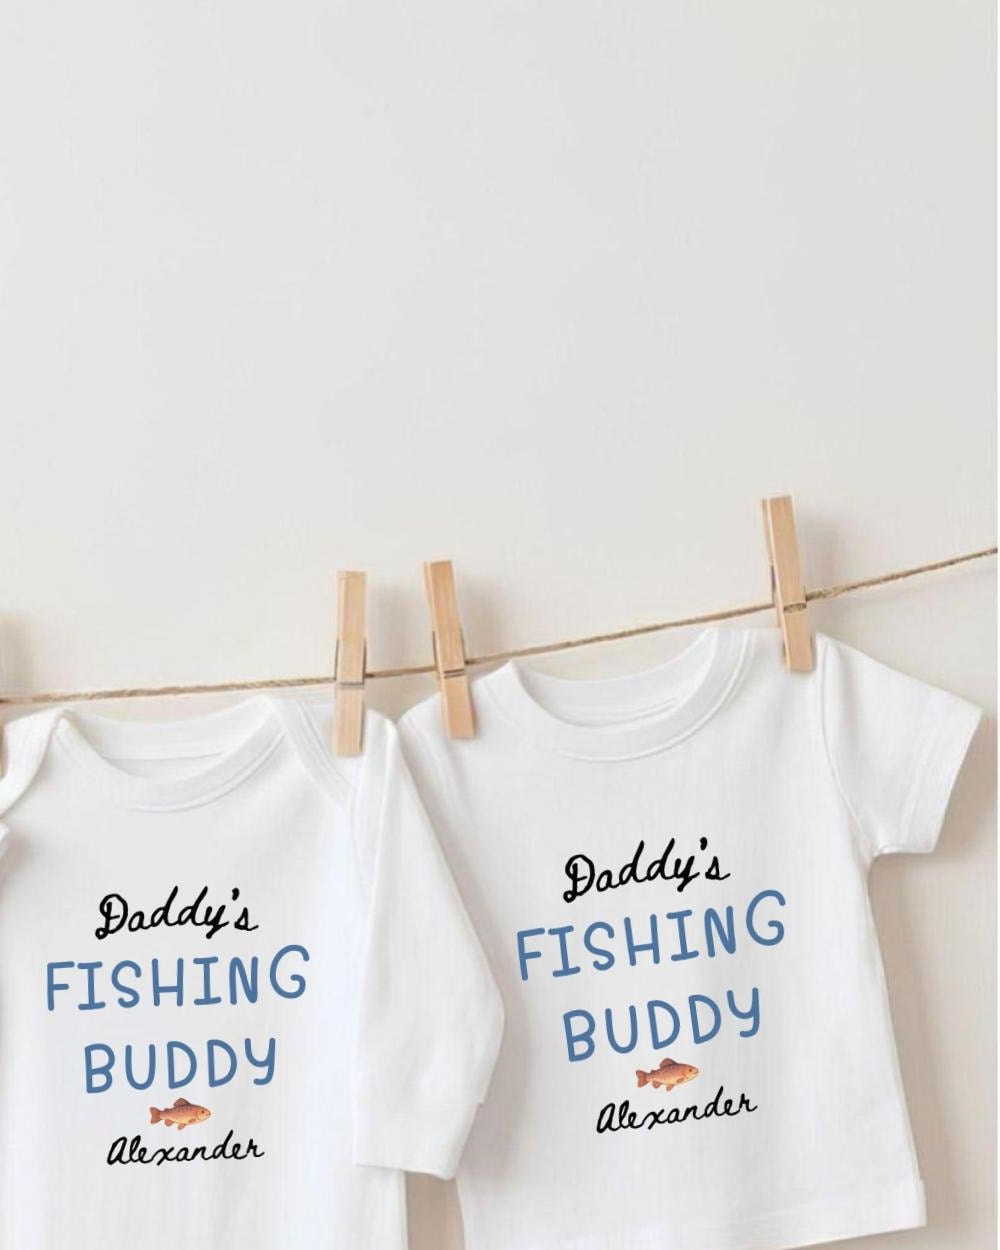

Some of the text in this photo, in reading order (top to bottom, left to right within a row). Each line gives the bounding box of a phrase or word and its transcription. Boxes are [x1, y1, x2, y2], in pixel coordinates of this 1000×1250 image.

[562, 836, 732, 904] Daddy's
[94, 885, 260, 940] Daddy's
[517, 890, 786, 981] FISHING
[46, 944, 310, 1011] FISHING
[563, 987, 761, 1062] BUDDY
[84, 1039, 276, 1094] BUDDY
[596, 1085, 758, 1134] Alexander
[106, 1129, 265, 1166] Alexander
